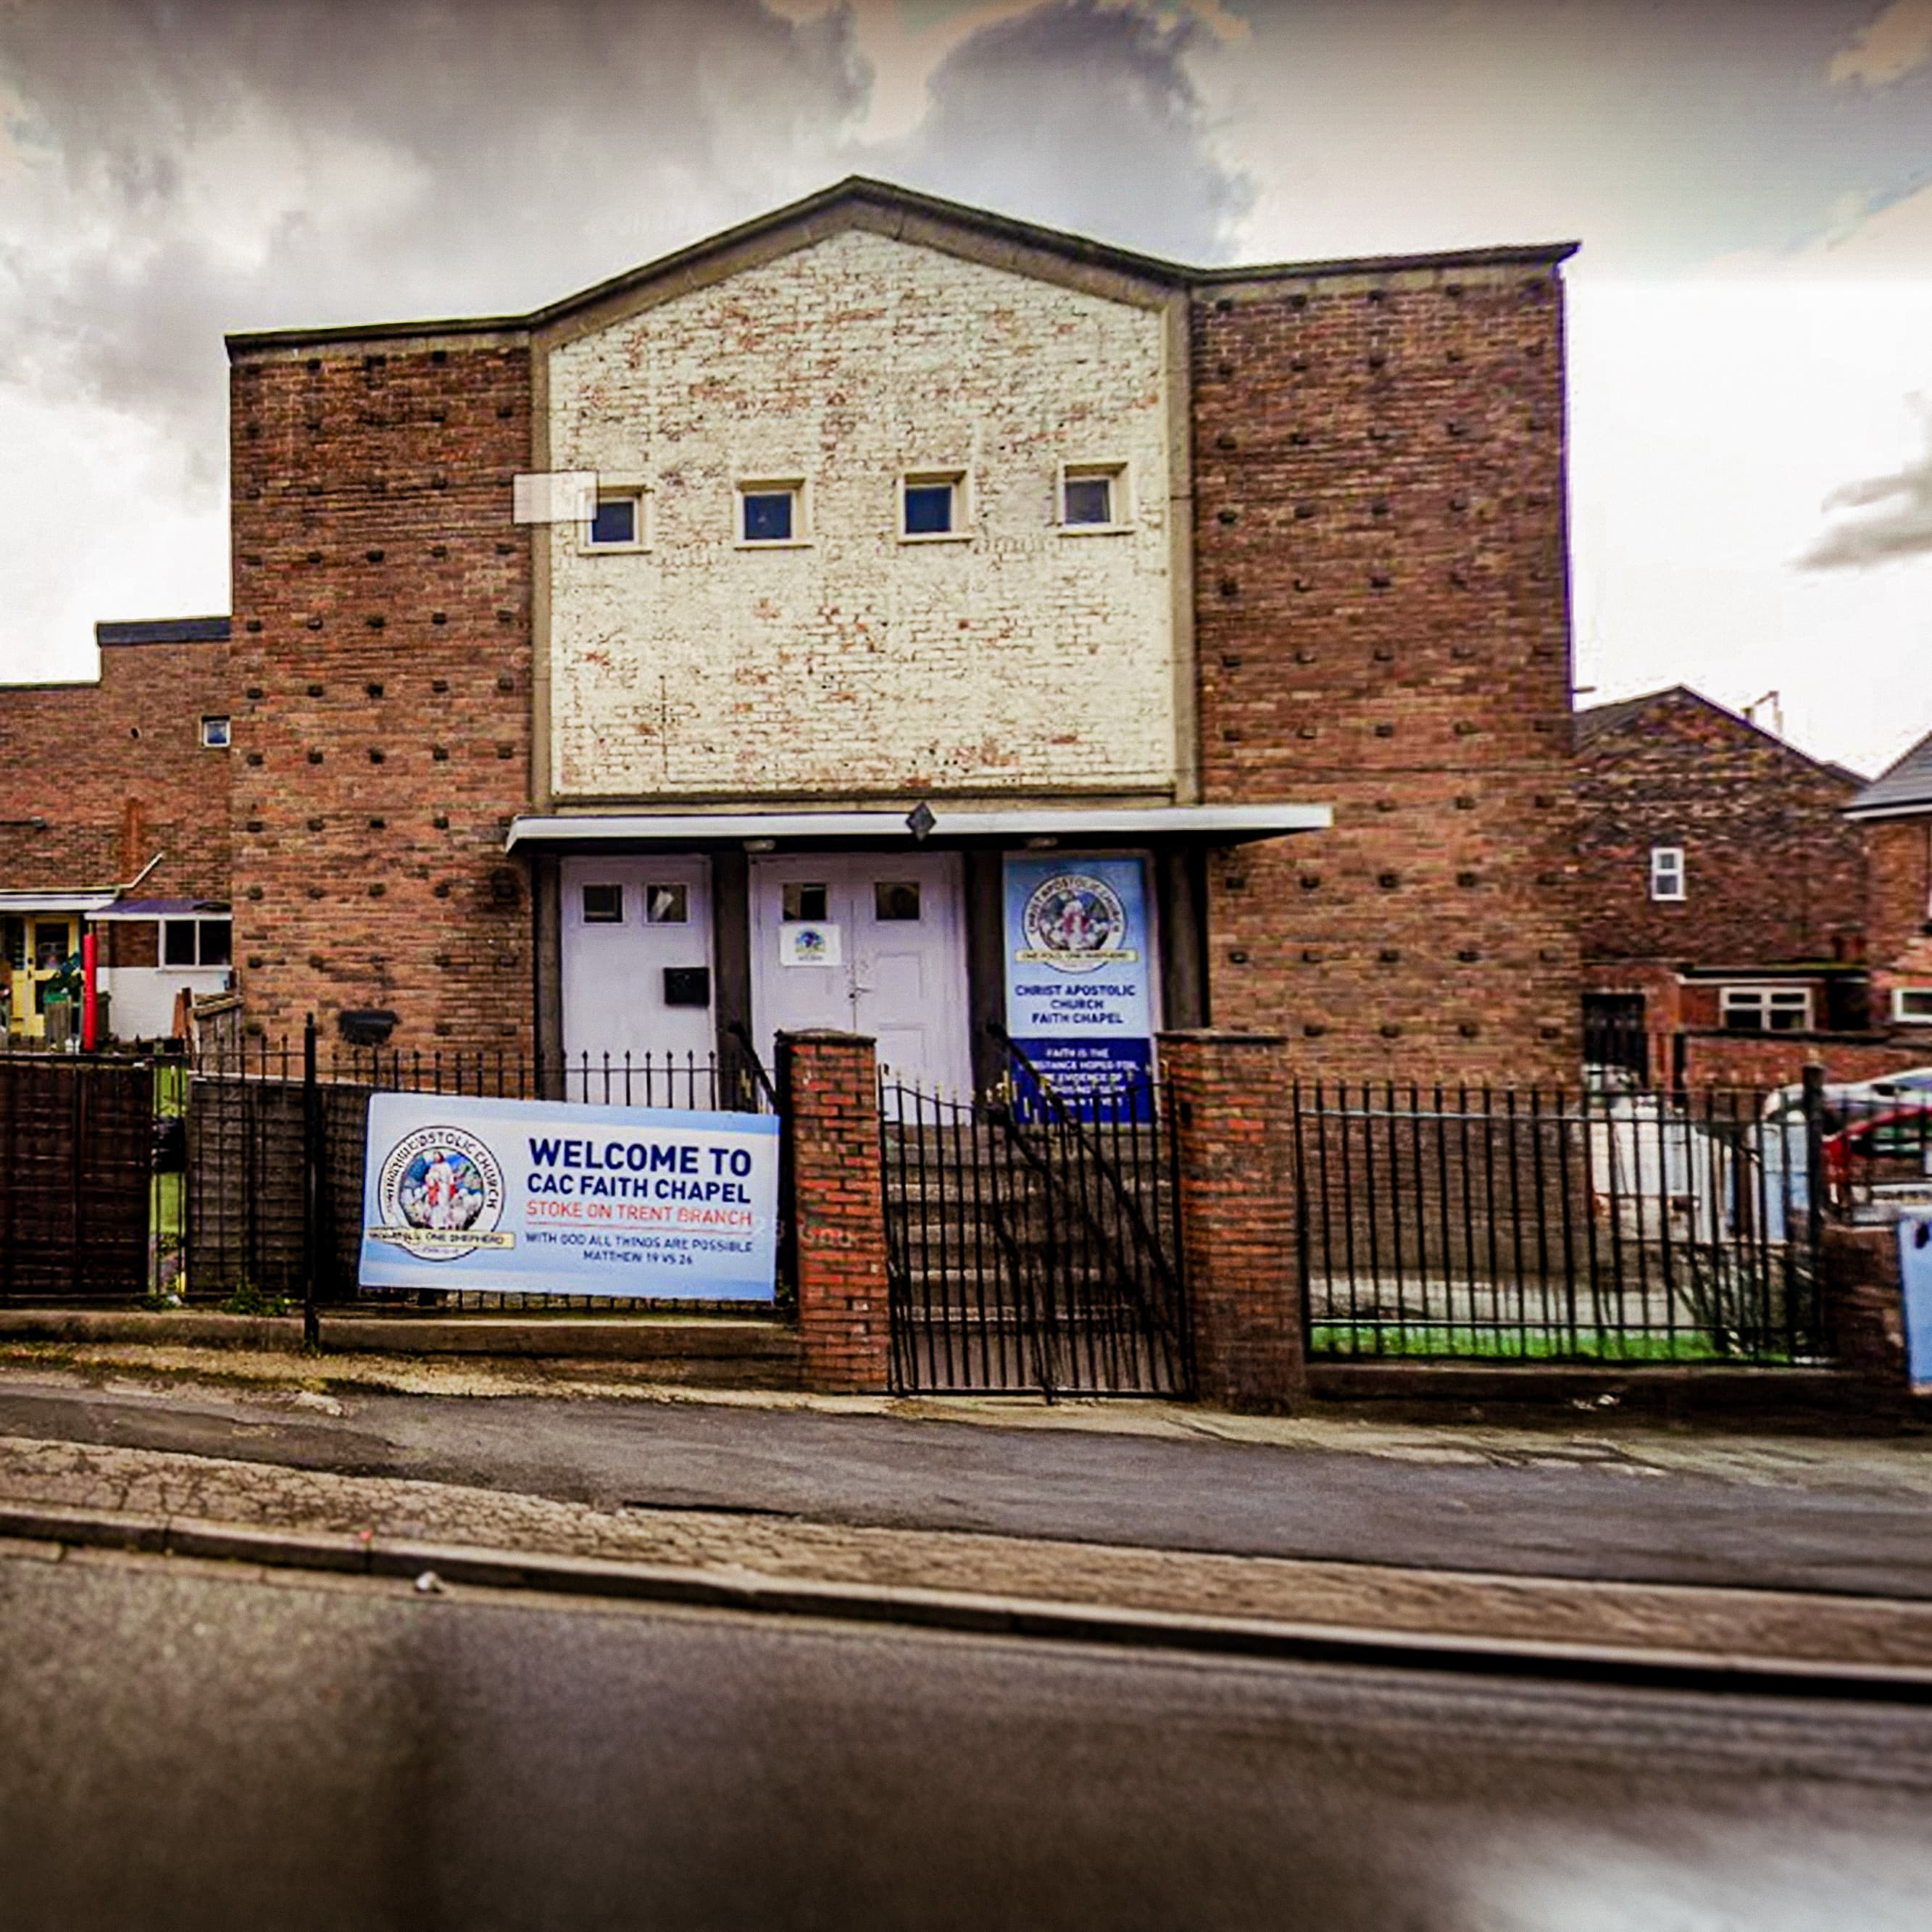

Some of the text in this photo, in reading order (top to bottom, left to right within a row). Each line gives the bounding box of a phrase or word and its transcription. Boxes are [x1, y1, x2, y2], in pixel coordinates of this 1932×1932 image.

[1015, 985, 1136, 996] CHRIST APOSTOLIC
[1051, 999, 1104, 1009] CHURCH
[1031, 1013, 1125, 1024] FAITH CHAPEL
[1046, 1048, 1109, 1058] FAITH IS THE
[528, 1138, 751, 1178] WELCOME TO
[528, 1173, 751, 1204] CAC FAITH CHAPEL
[527, 1199, 752, 1226] STOKE ON TRENT BRANCH
[525, 1232, 753, 1253] WITH GOD ALL THINGS ARE POSSIBLE
[583, 1250, 694, 1266] MATTHEW 19 VS 26
